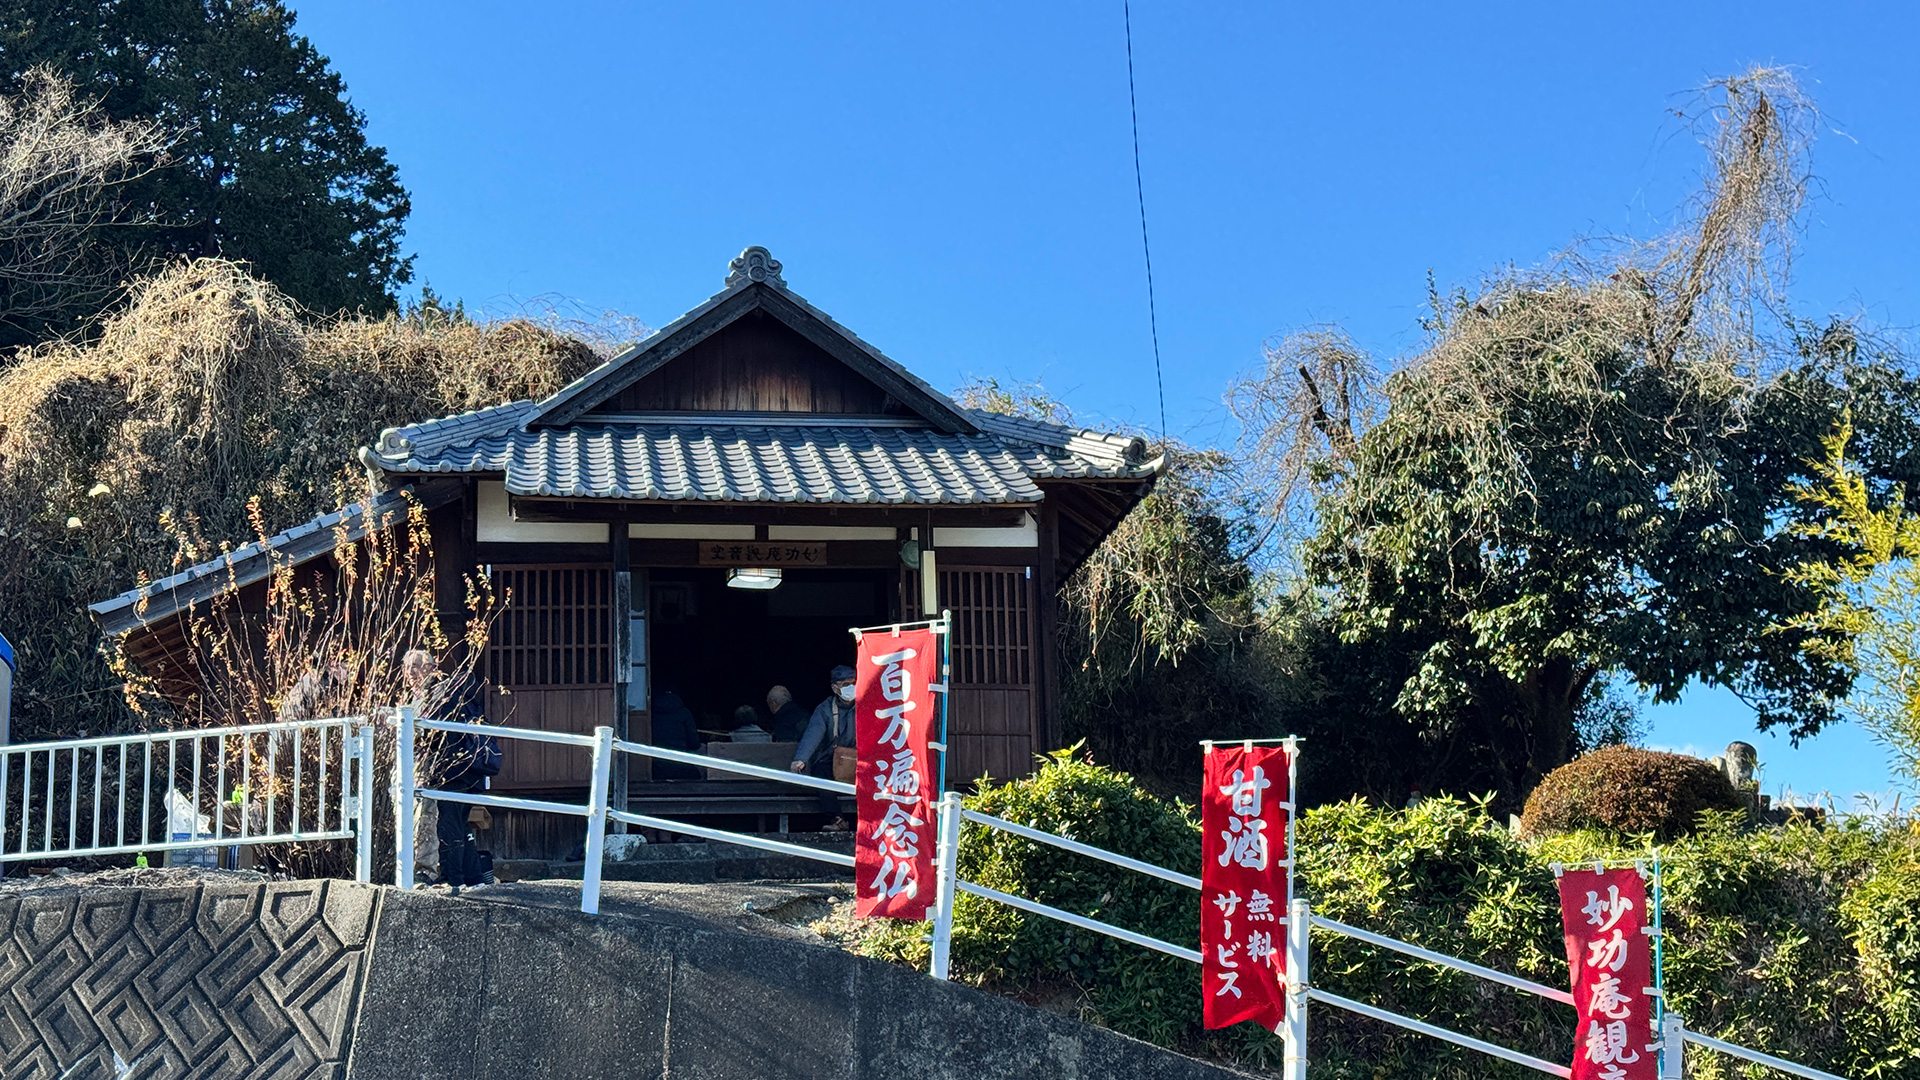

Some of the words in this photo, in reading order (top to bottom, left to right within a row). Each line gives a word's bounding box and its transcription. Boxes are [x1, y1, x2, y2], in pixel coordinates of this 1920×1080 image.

[870, 648, 924, 902] 百万遍念仏
[1218, 765, 1271, 871] 甘酒
[1213, 889, 1243, 999] サービス
[1246, 889, 1275, 968] 無料
